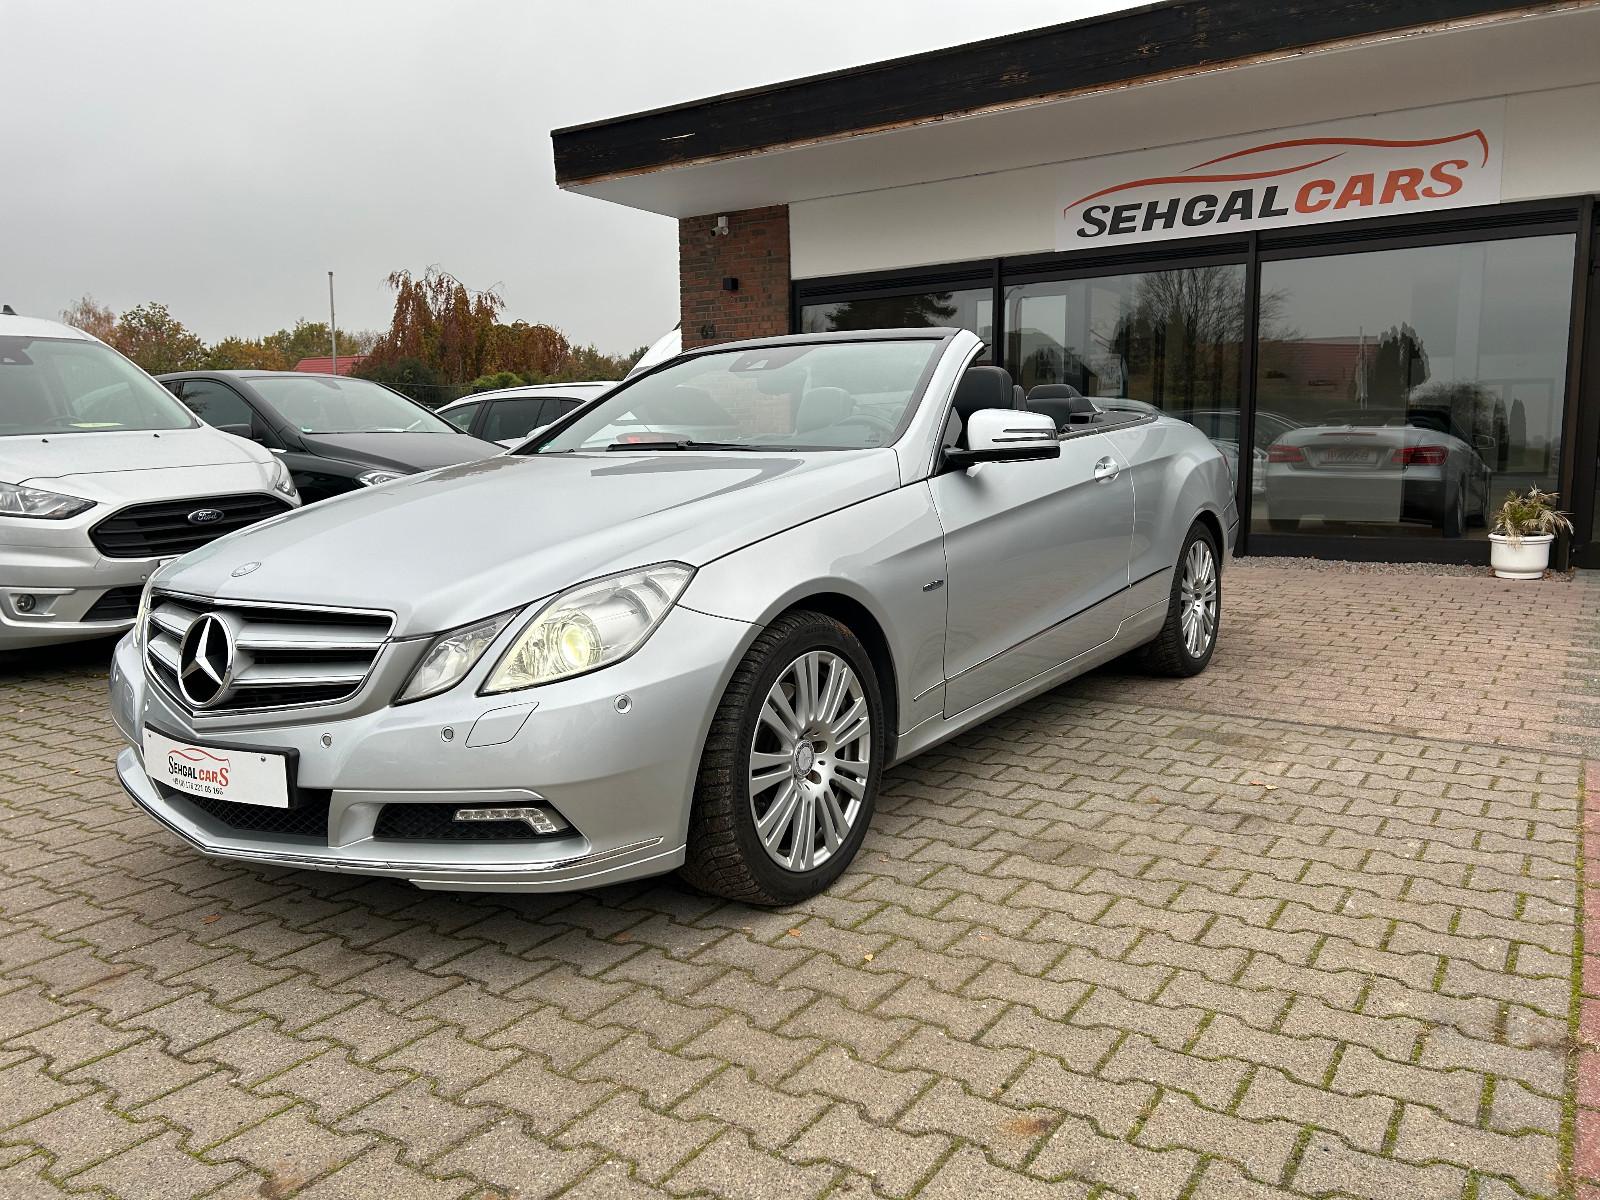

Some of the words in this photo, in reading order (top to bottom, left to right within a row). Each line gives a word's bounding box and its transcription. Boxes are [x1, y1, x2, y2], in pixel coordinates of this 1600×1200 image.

[1076, 185, 1289, 238] SEHGAL
[1294, 159, 1469, 214] CARS
[168, 755, 198, 780] SEHGAL
[198, 767, 229, 787] CARS
